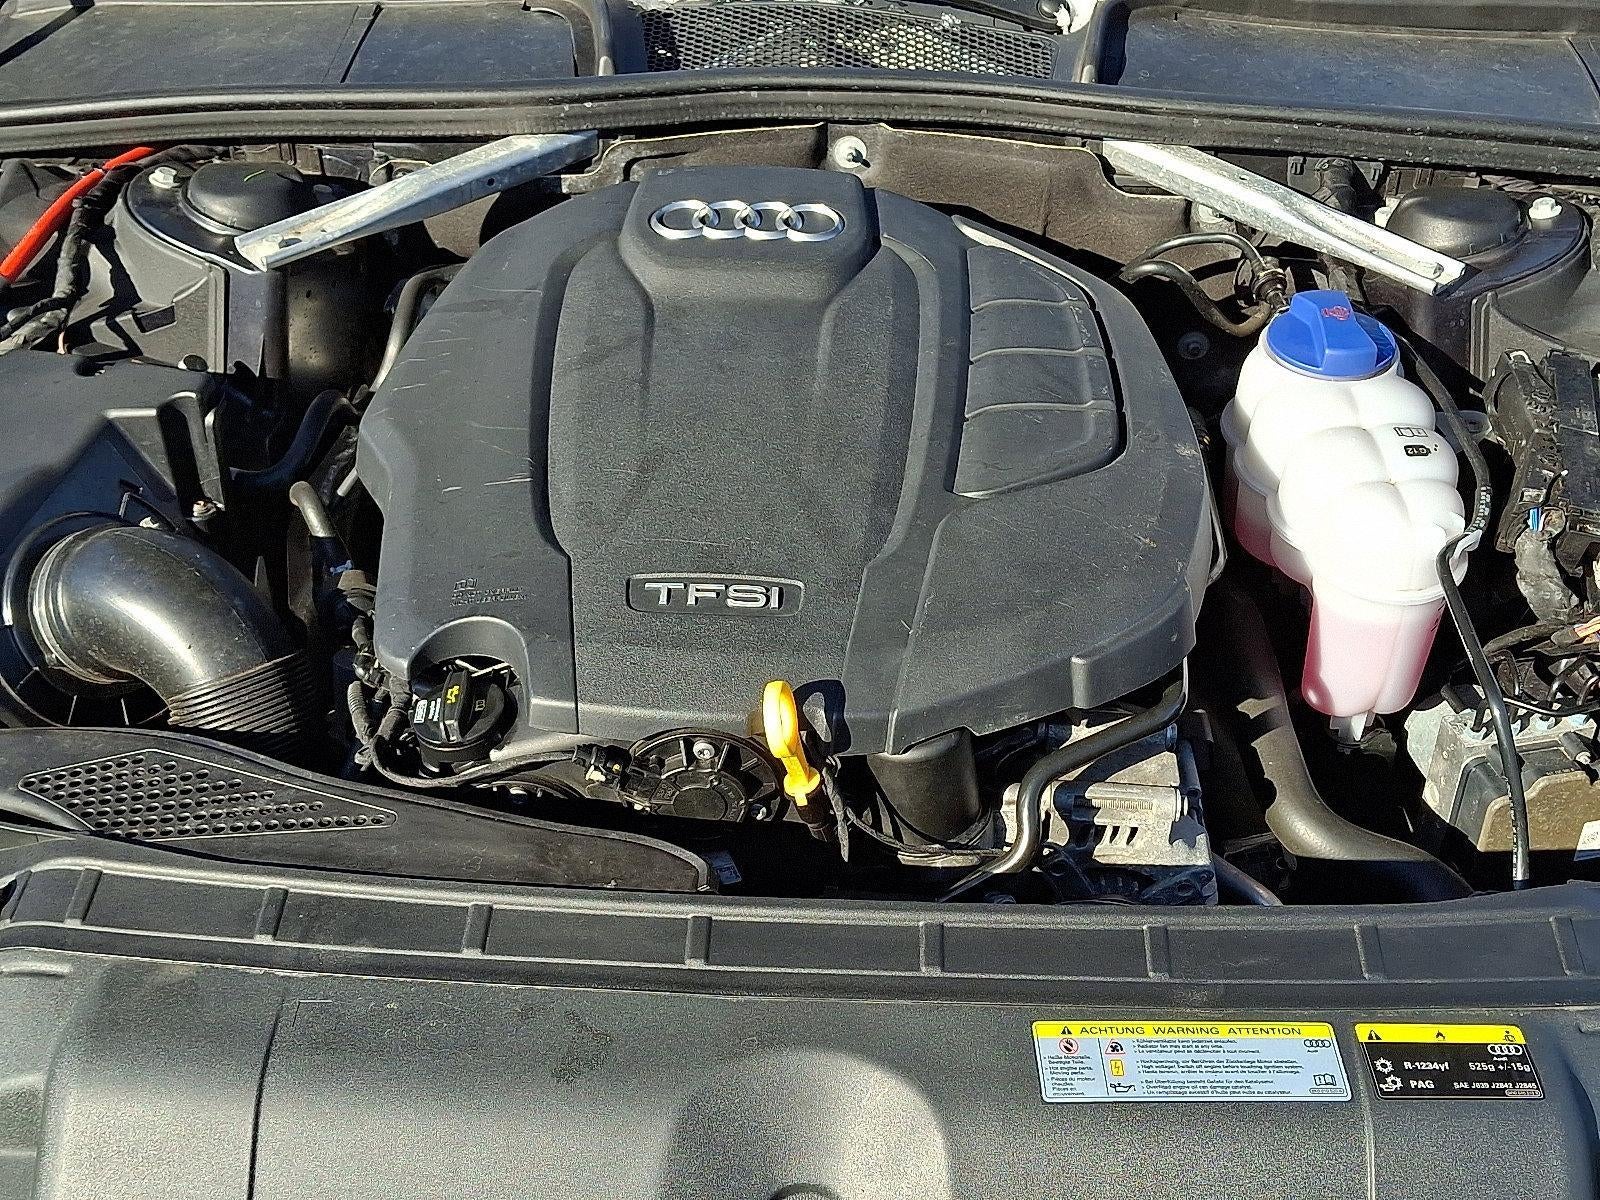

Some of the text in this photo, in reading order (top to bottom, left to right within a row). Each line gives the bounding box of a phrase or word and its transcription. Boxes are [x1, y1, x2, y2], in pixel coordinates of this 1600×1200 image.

[645, 582, 780, 610] TFSI
[1080, 1026, 1302, 1035] ACHTUNG WARNING ATTENTION
[1403, 1061, 1450, 1071] R-1234yf
[1468, 1062, 1496, 1072] 525g
[1410, 1080, 1435, 1089] PAG
[1453, 1081, 1470, 1089] SAE
